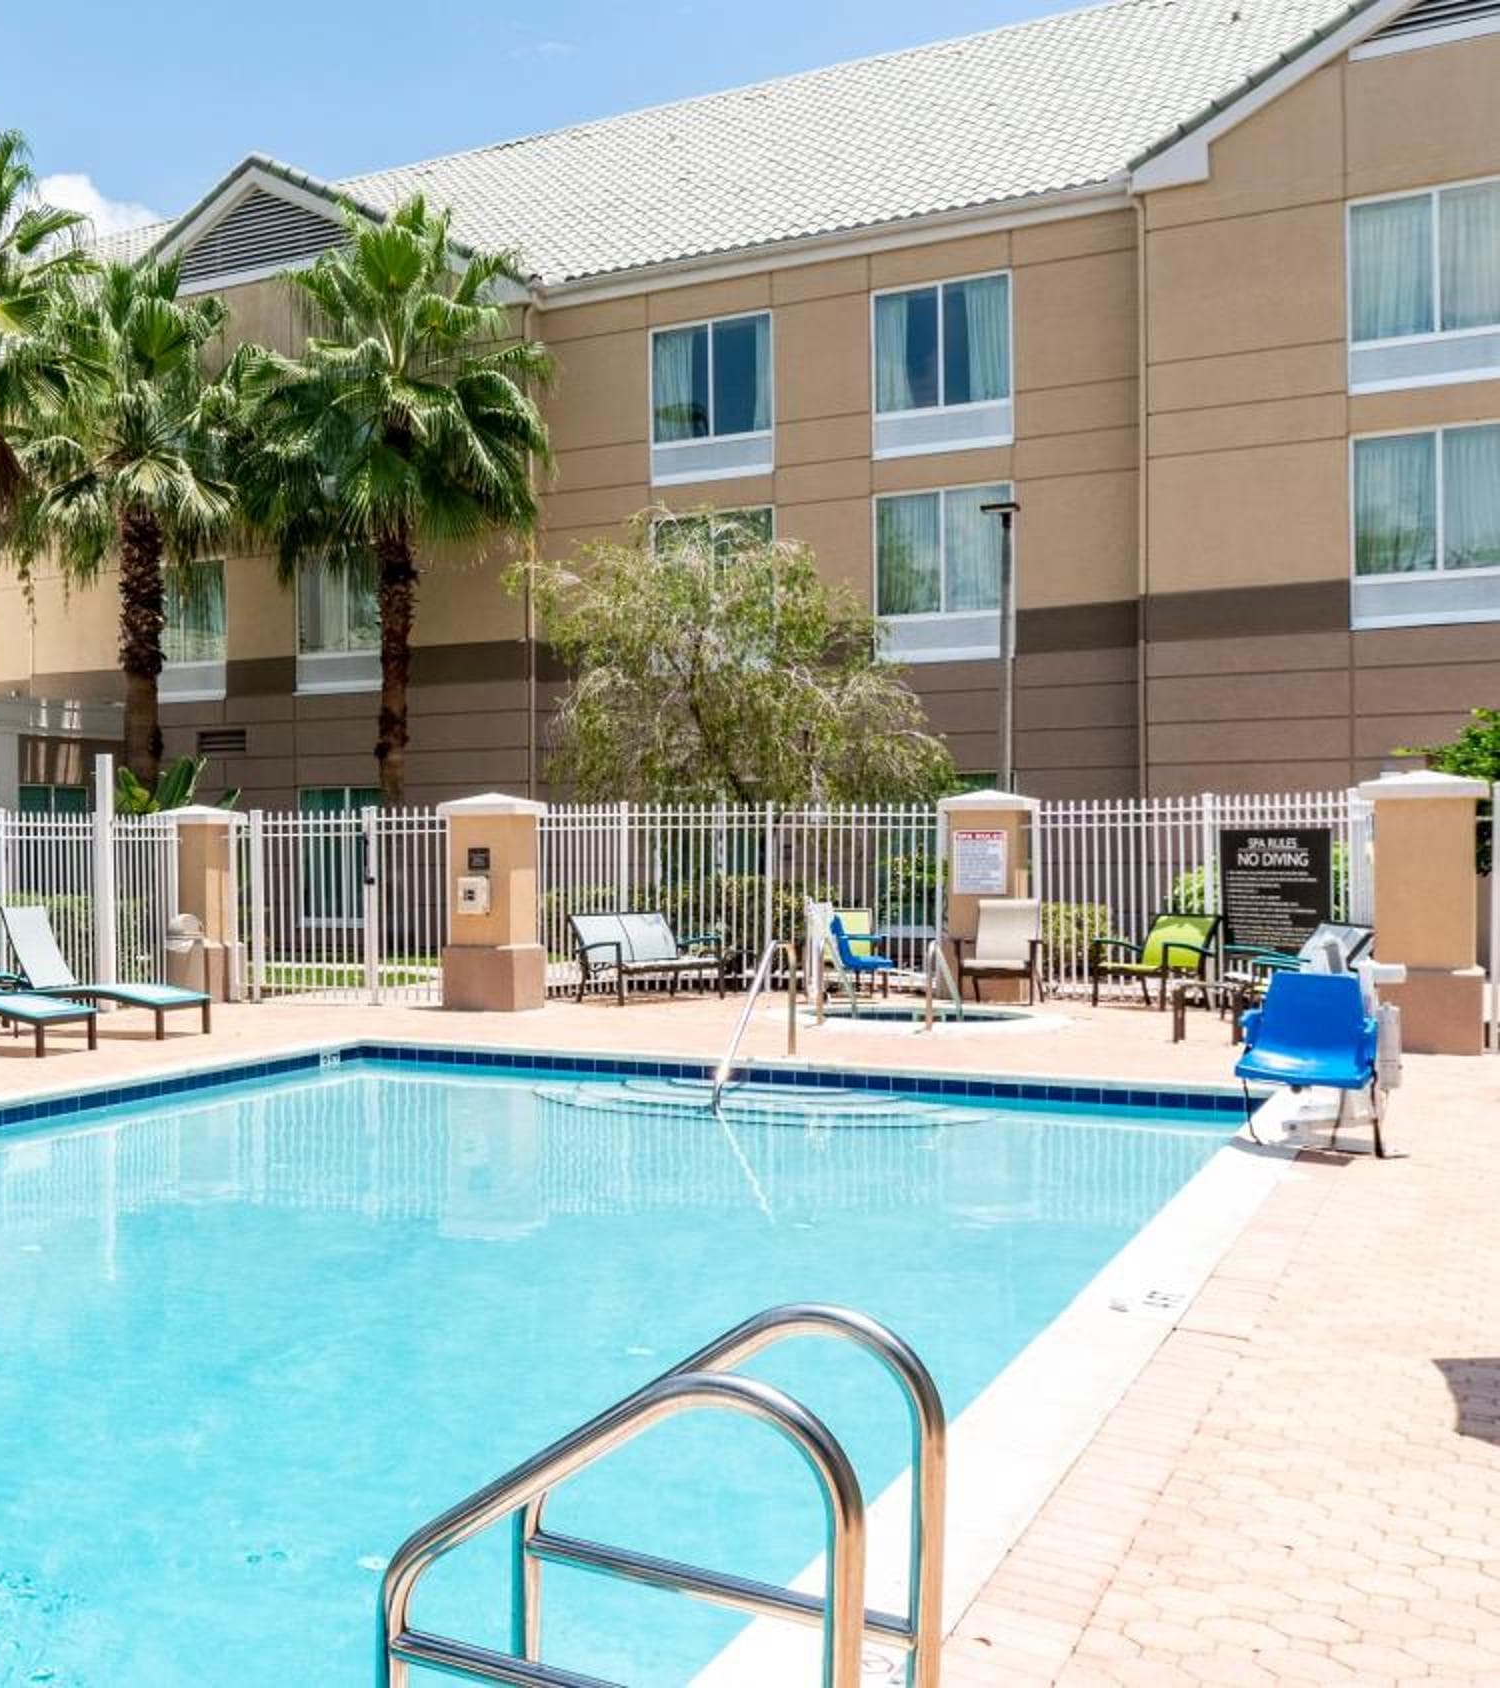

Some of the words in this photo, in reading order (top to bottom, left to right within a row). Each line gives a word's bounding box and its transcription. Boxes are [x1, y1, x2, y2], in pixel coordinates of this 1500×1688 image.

[1247, 837, 1266, 849] SPA
[1267, 837, 1298, 849] RULES
[1237, 853, 1259, 867] NO
[1262, 853, 1309, 867] DIVING
